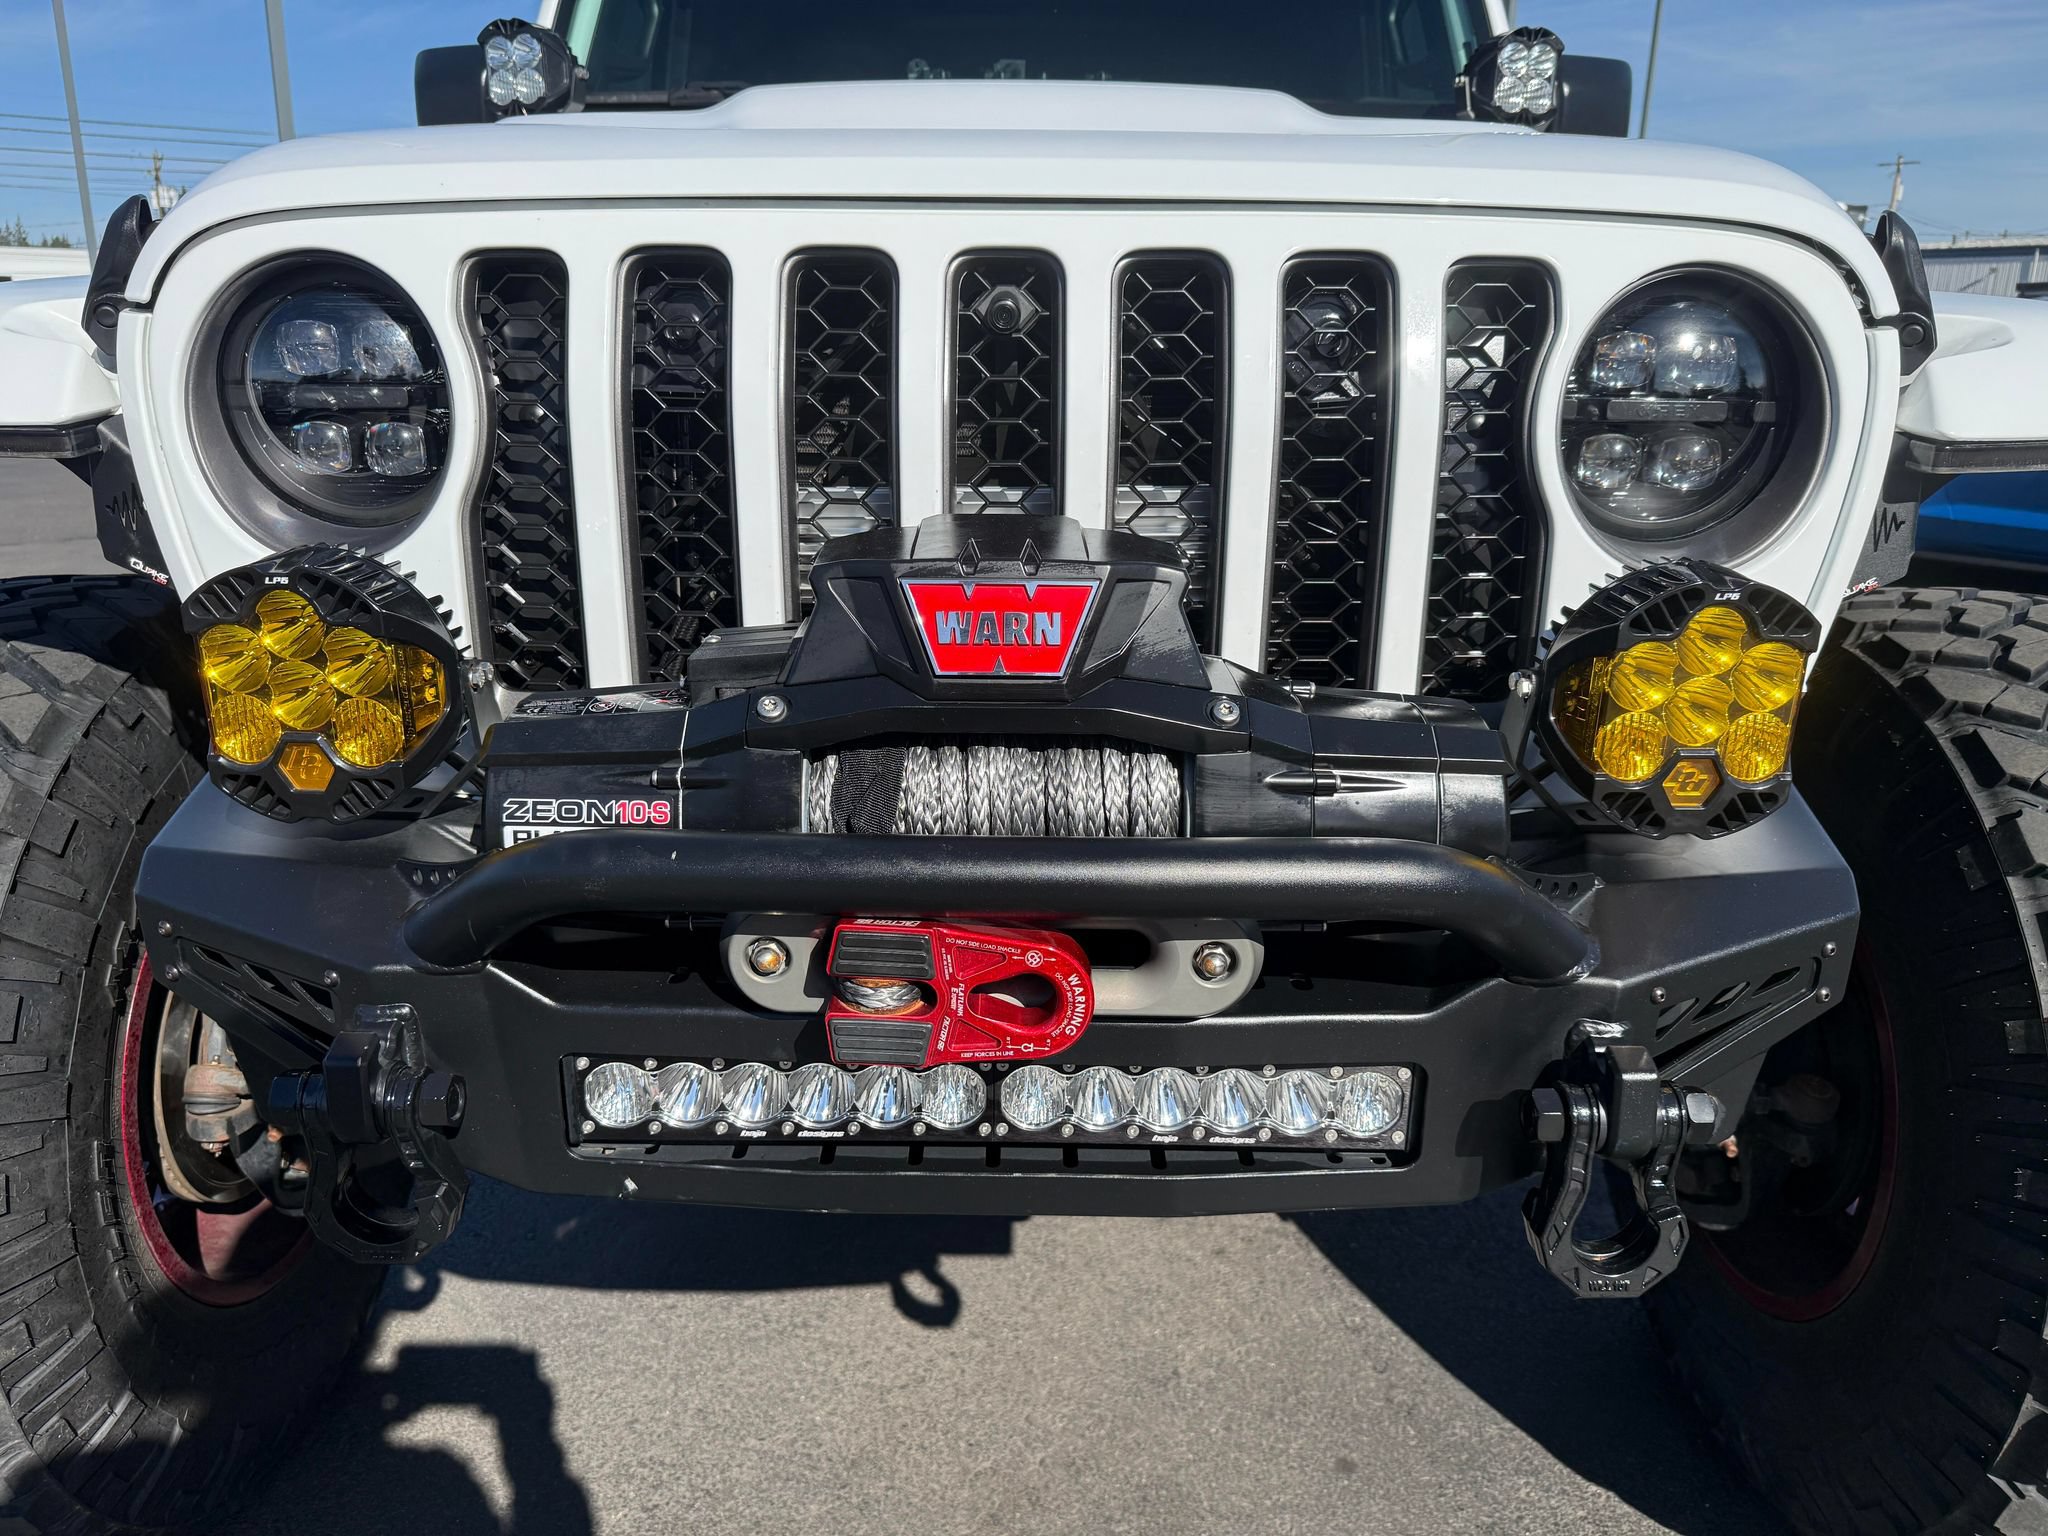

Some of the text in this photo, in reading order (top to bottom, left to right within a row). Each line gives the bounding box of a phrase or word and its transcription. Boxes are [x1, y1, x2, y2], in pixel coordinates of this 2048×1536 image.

[264, 576, 289, 584] LP6
[1714, 592, 1741, 601] LP6
[935, 610, 1062, 646] WARN
[968, 940, 980, 948] SIDE
[997, 945, 1022, 954] SHACKLE
[1065, 973, 1086, 1036] WARNING
[740, 1129, 845, 1138] baja designs
[1151, 1134, 1256, 1144] baja designs
